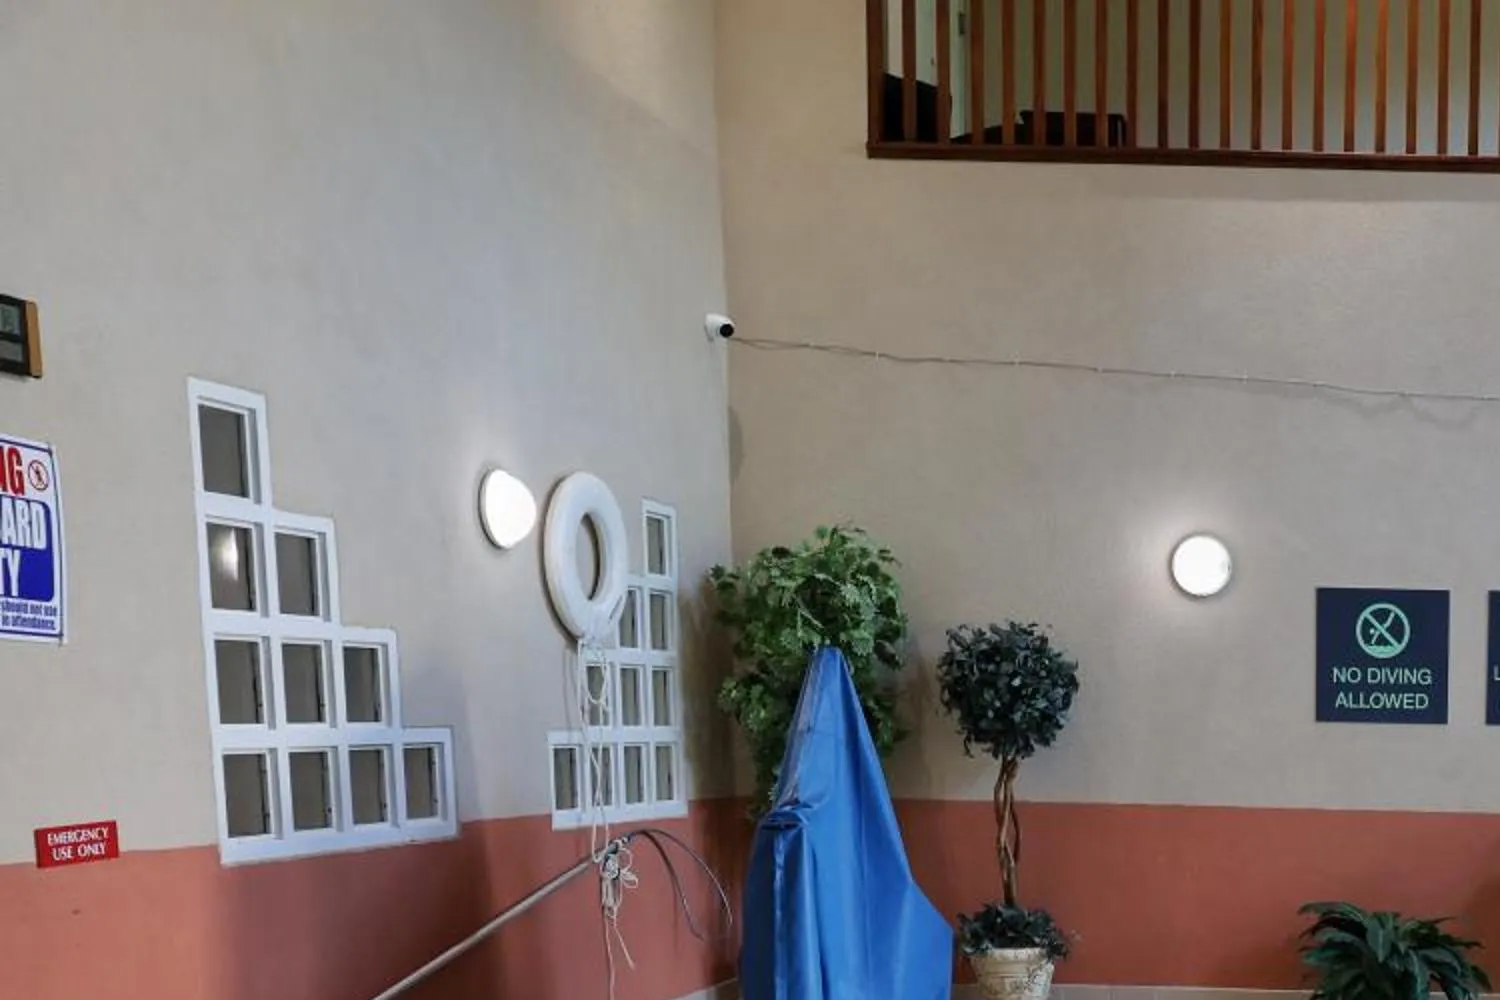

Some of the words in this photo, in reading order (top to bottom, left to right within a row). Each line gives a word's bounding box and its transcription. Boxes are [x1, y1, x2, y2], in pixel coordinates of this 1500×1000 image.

[1332, 667, 1362, 684] NO
[1367, 667, 1432, 685] DIVING
[1335, 691, 1429, 709] ALLOWED
[47, 827, 109, 846] EMERGENCY
[52, 845, 74, 861] USE
[77, 841, 107, 857] ONLY
